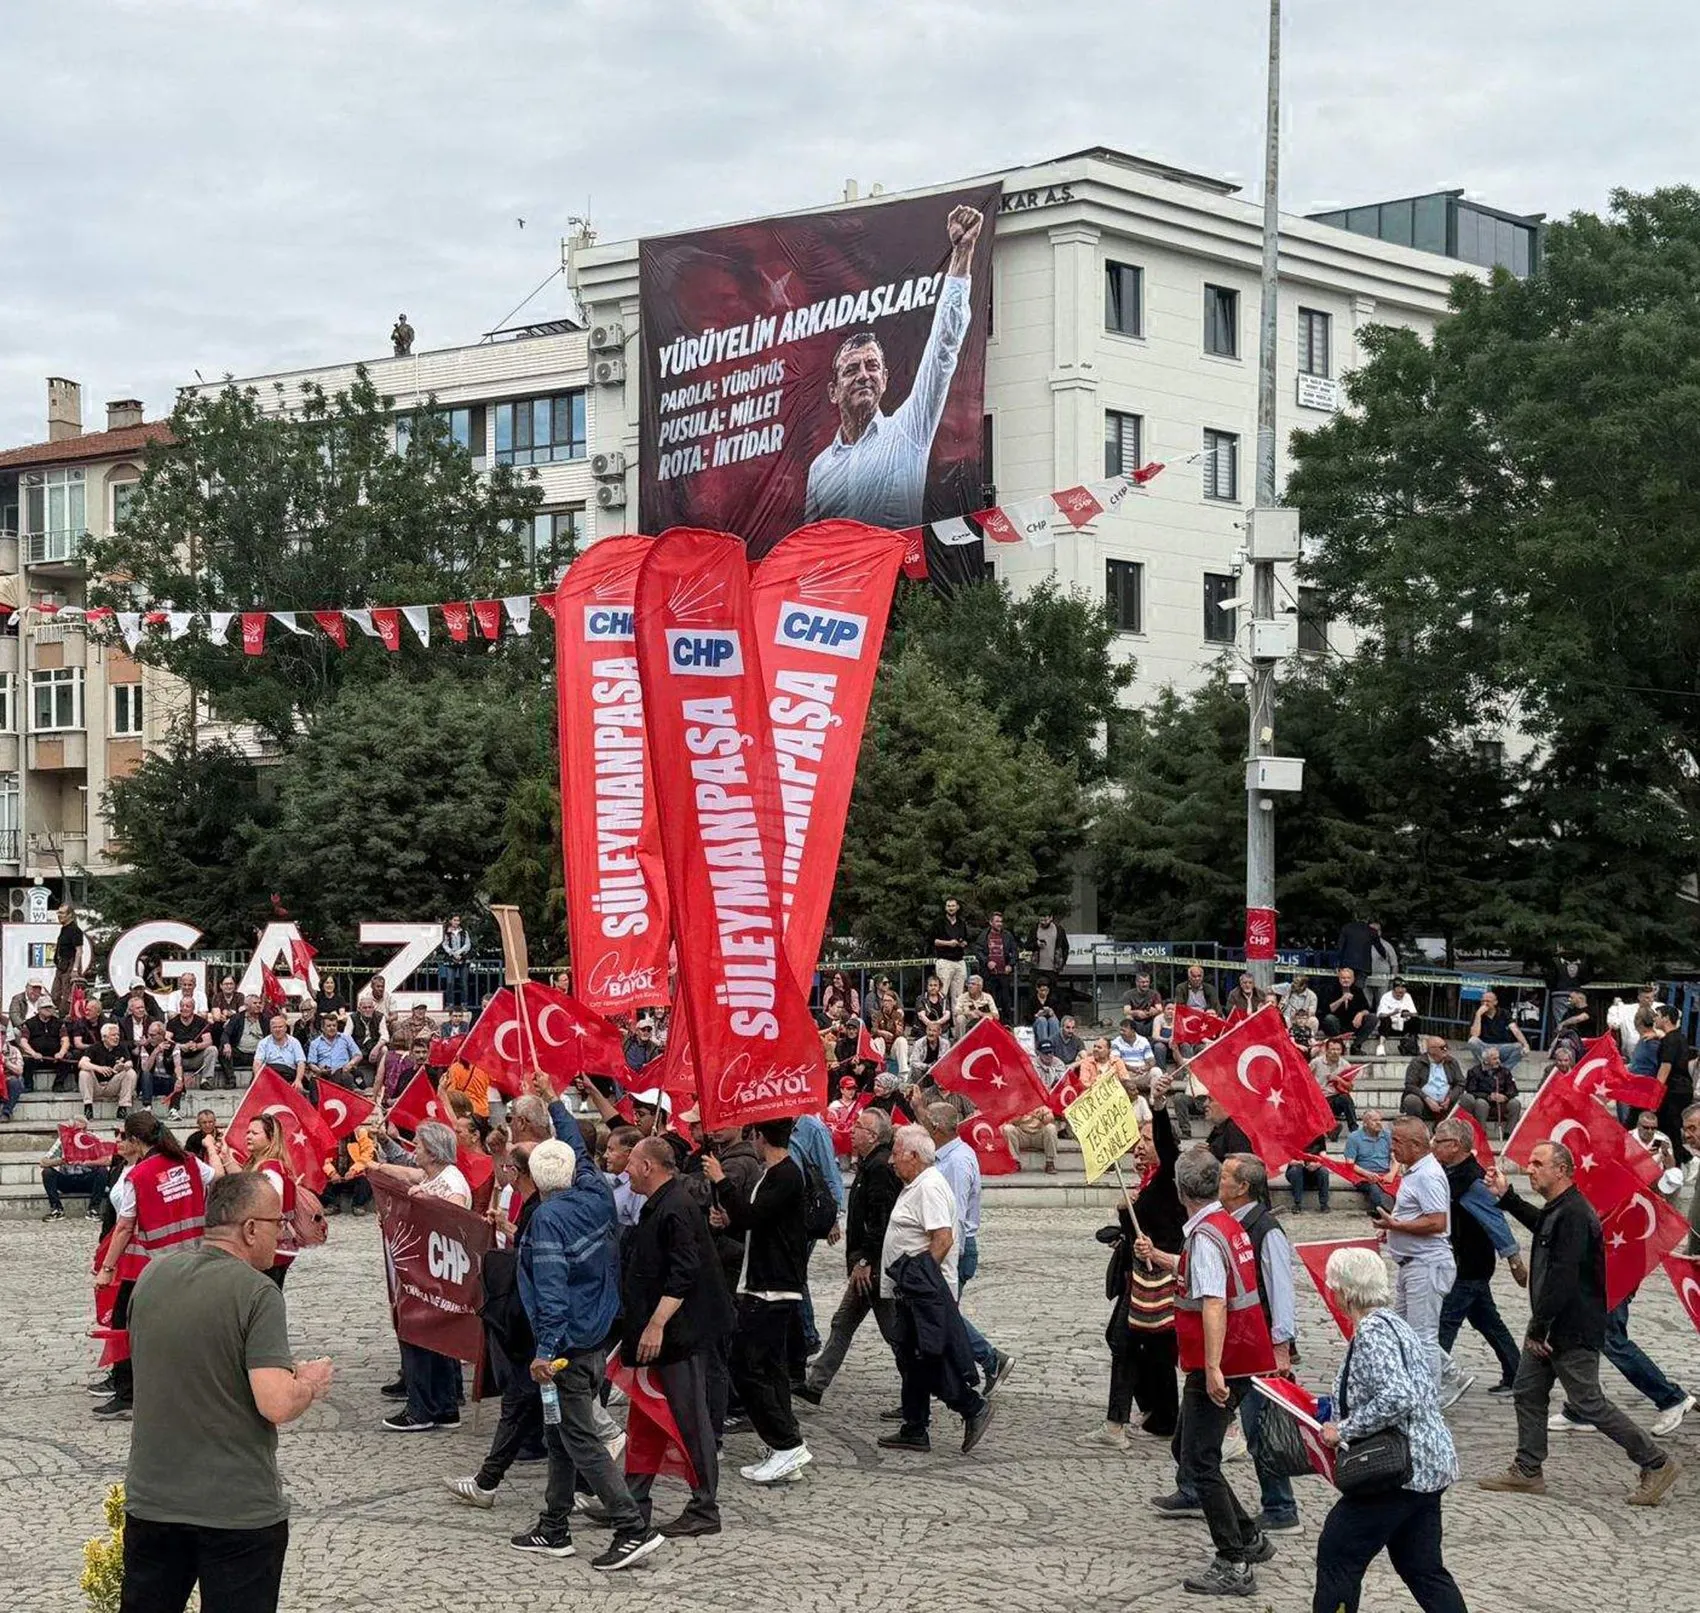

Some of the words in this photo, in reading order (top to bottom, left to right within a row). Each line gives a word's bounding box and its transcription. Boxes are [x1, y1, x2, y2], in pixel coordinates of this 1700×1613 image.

[998, 192, 1038, 212] KAR
[1044, 185, 1075, 205] A.Ş.
[659, 315, 778, 379] YÜRÜYELİM
[778, 272, 943, 345] ARKADAŞLAR!
[659, 381, 717, 414] PAROLA:
[721, 358, 786, 399] YÜRÜYÜŞ
[658, 412, 725, 448] PUSULA:
[729, 389, 784, 429] MİLLET
[658, 445, 709, 481] ROTA:
[712, 423, 785, 468] İKTİDAR
[1110, 486, 1128, 505] CHP
[1026, 520, 1047, 533] CHP
[904, 552, 920, 564] CHP
[783, 611, 859, 647] CHP
[672, 636, 734, 668] CHP
[681, 695, 780, 1040] SÜLEYMANPAŞA
[1249, 935, 1270, 946] CHP
[1273, 953, 1300, 966] OLİS
[608, 972, 655, 997] BAYOL
[741, 1075, 811, 1105] BAYOL
[428, 1231, 470, 1285] CHP
